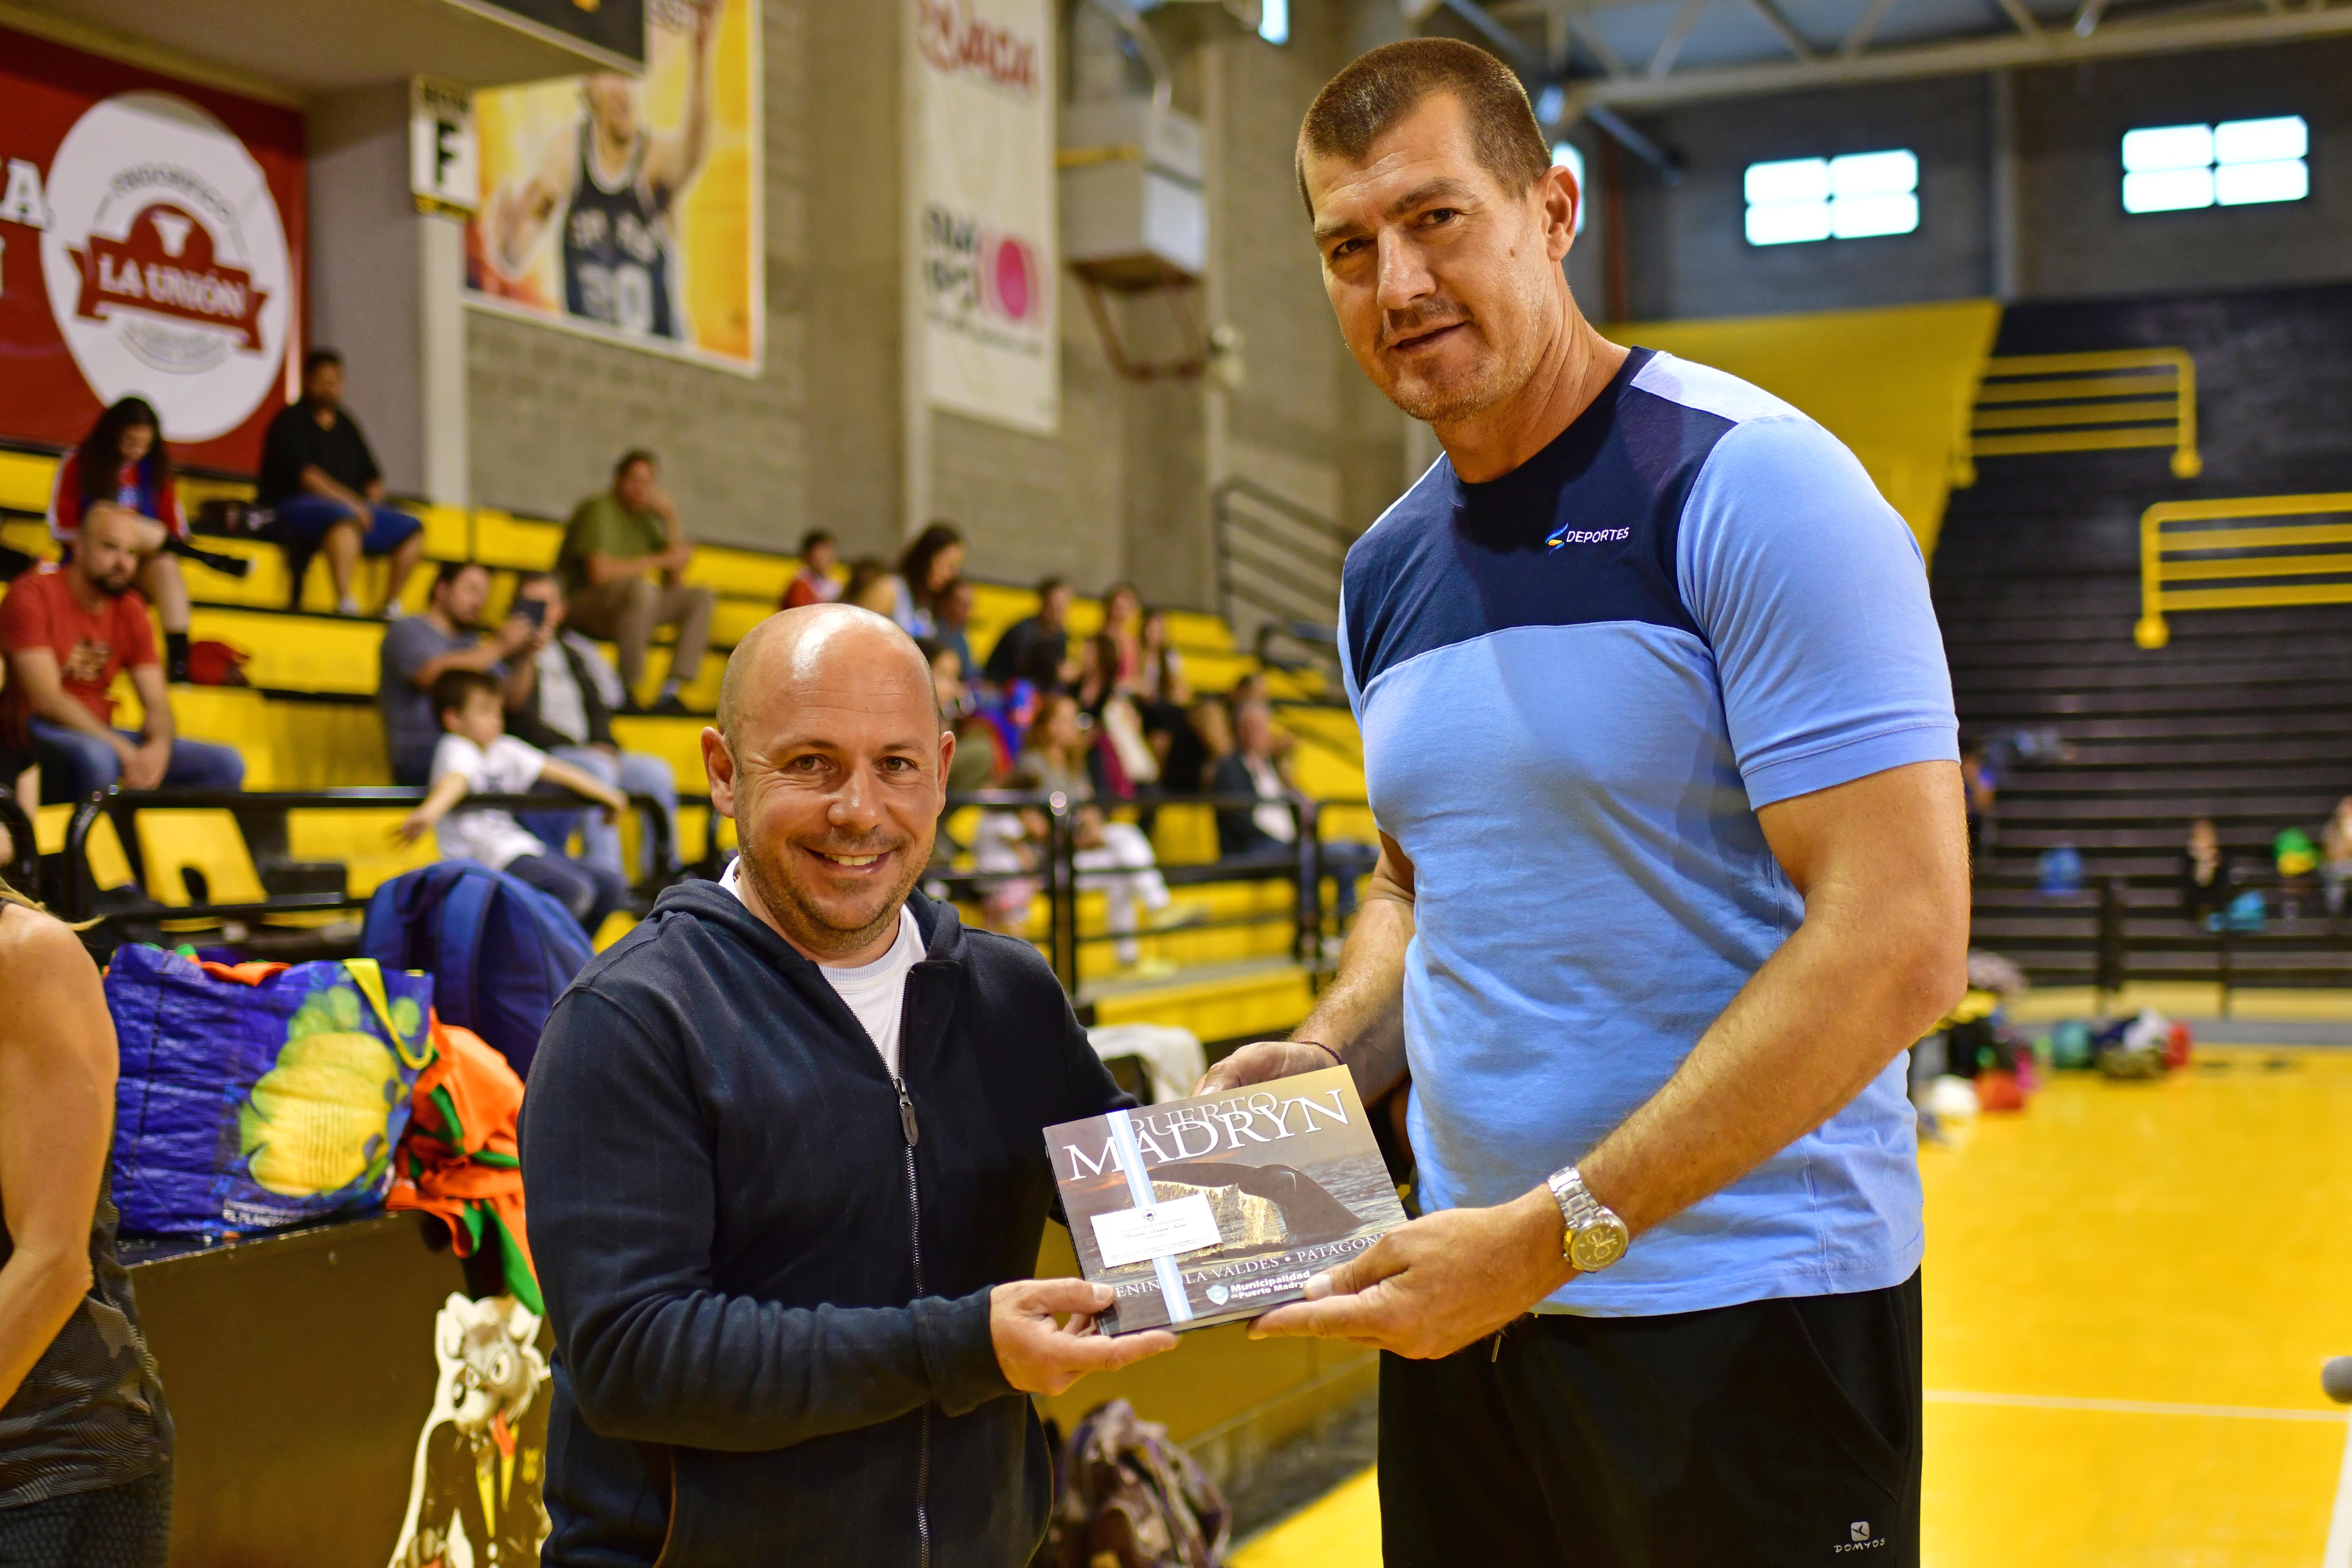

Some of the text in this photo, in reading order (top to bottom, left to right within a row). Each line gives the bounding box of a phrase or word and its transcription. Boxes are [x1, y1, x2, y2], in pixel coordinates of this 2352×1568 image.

[436, 121, 458, 186] F
[0, 157, 53, 232] A
[99, 253, 246, 319] LA UNIÓN
[1566, 527, 1630, 543] DEPORTES
[1063, 1088, 1349, 1181] MADRYN
[1130, 1092, 1278, 1136] PUERTO
[1115, 1233, 1384, 1298] ENINLA VALDES PATAGON
[1230, 1270, 1310, 1293] Municipalidad
[1238, 1288, 1271, 1299] Puerto
[1833, 1537, 1885, 1553] DOMYOS
